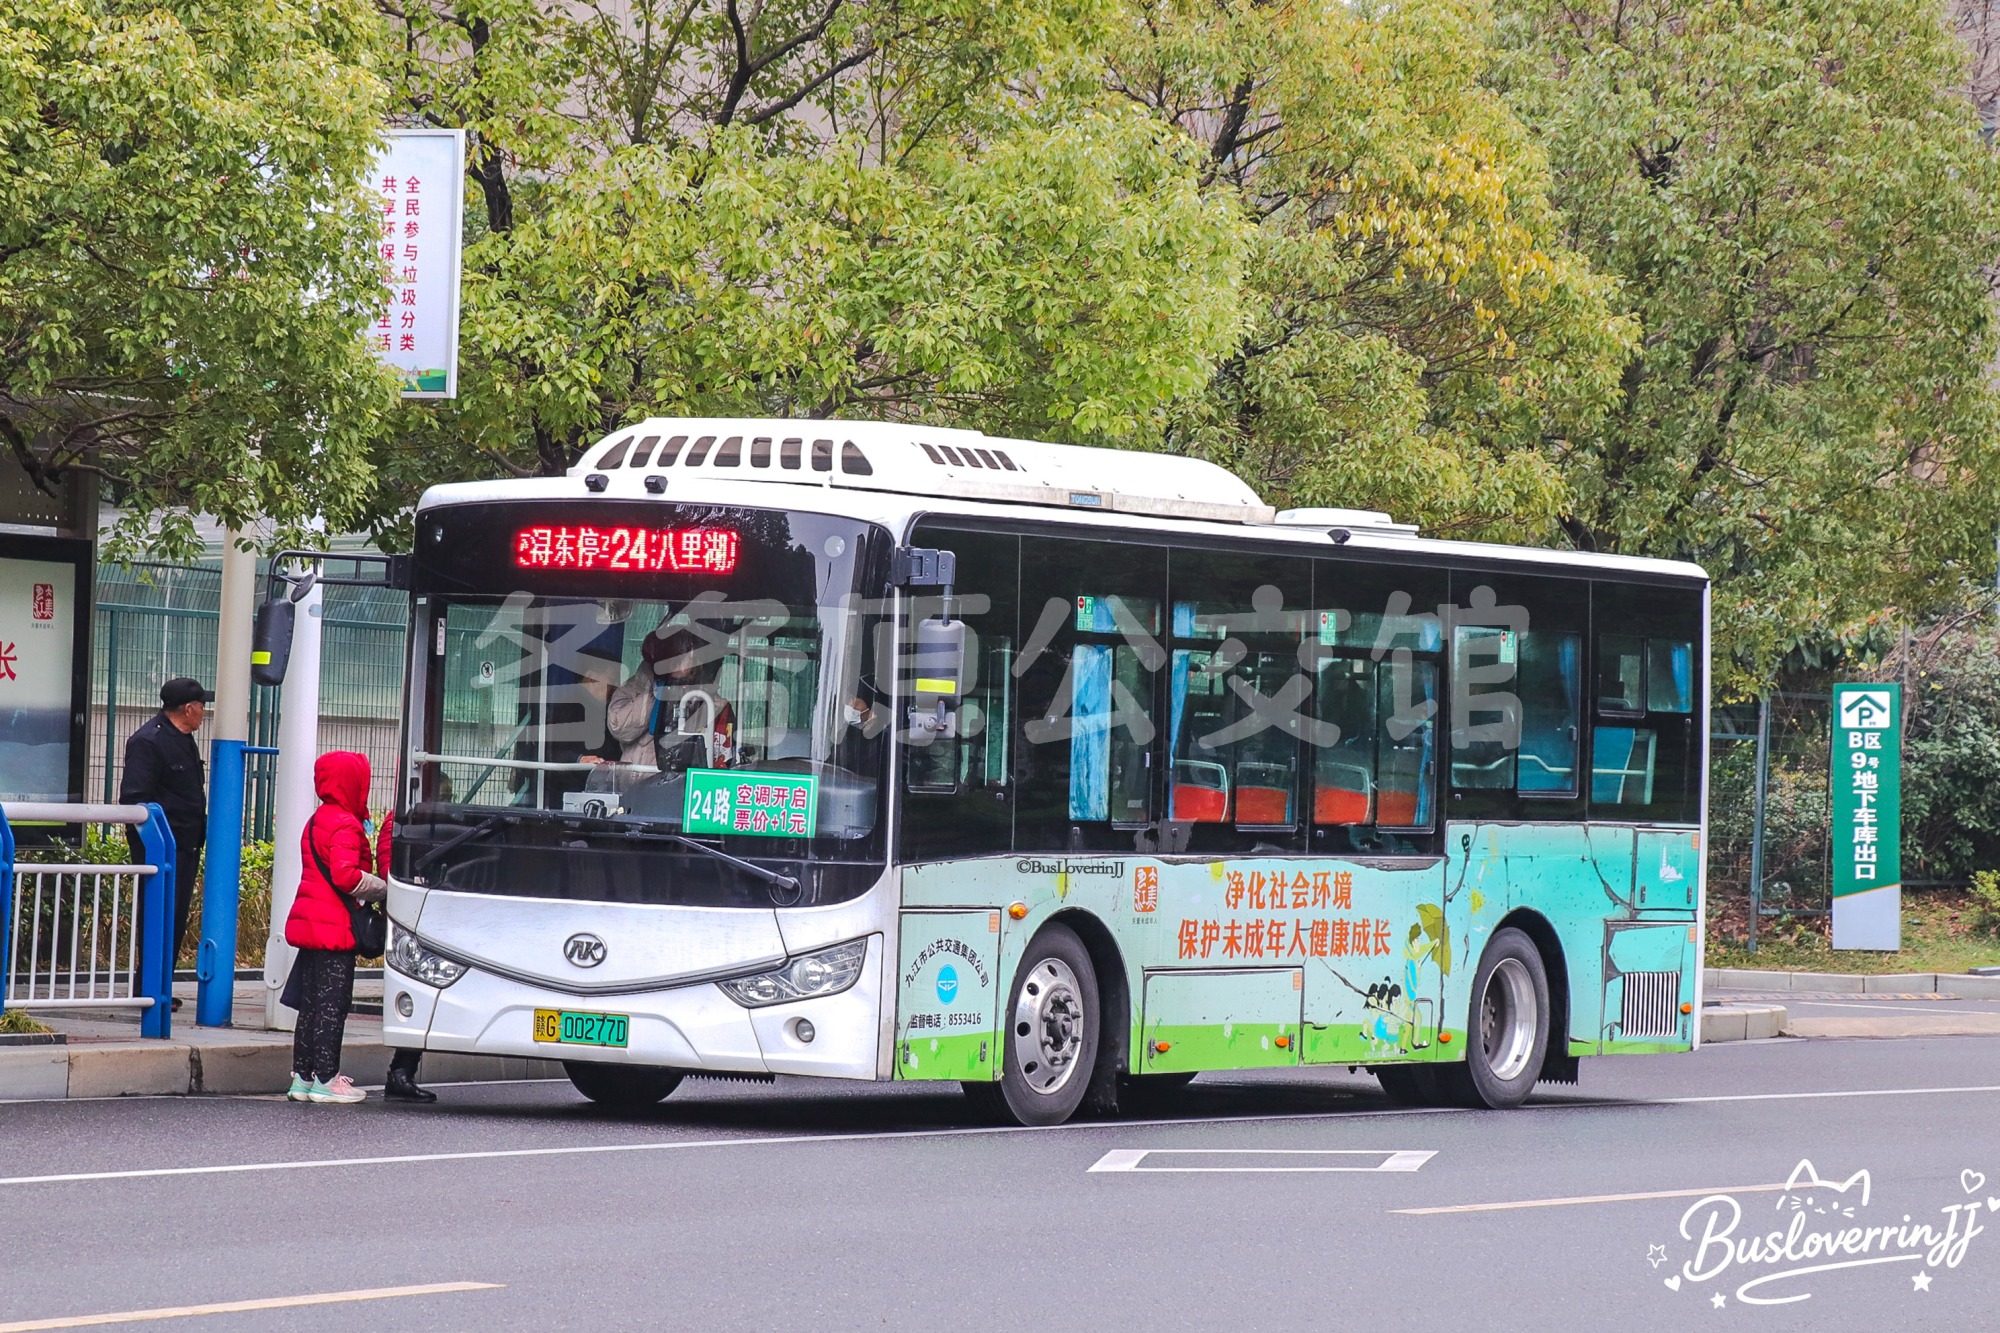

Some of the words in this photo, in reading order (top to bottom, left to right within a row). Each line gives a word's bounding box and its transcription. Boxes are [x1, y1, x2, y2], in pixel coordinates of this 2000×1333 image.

[376, 175, 397, 351] 共享环保生活
[400, 175, 421, 351] 全民参与垃圾分类
[1849, 731, 1882, 749] B区
[1851, 752, 1879, 769] 9号
[691, 788, 731, 825] 24路
[736, 783, 807, 809] 空调开启
[733, 808, 807, 834] 票价+1元
[1852, 770, 1879, 879] 地下车库出口
[1225, 870, 1354, 911] 净化社会环境
[1177, 918, 1392, 960] 保护未成年人健康成长
[905, 938, 989, 988] 九江市公共交通集团公司
